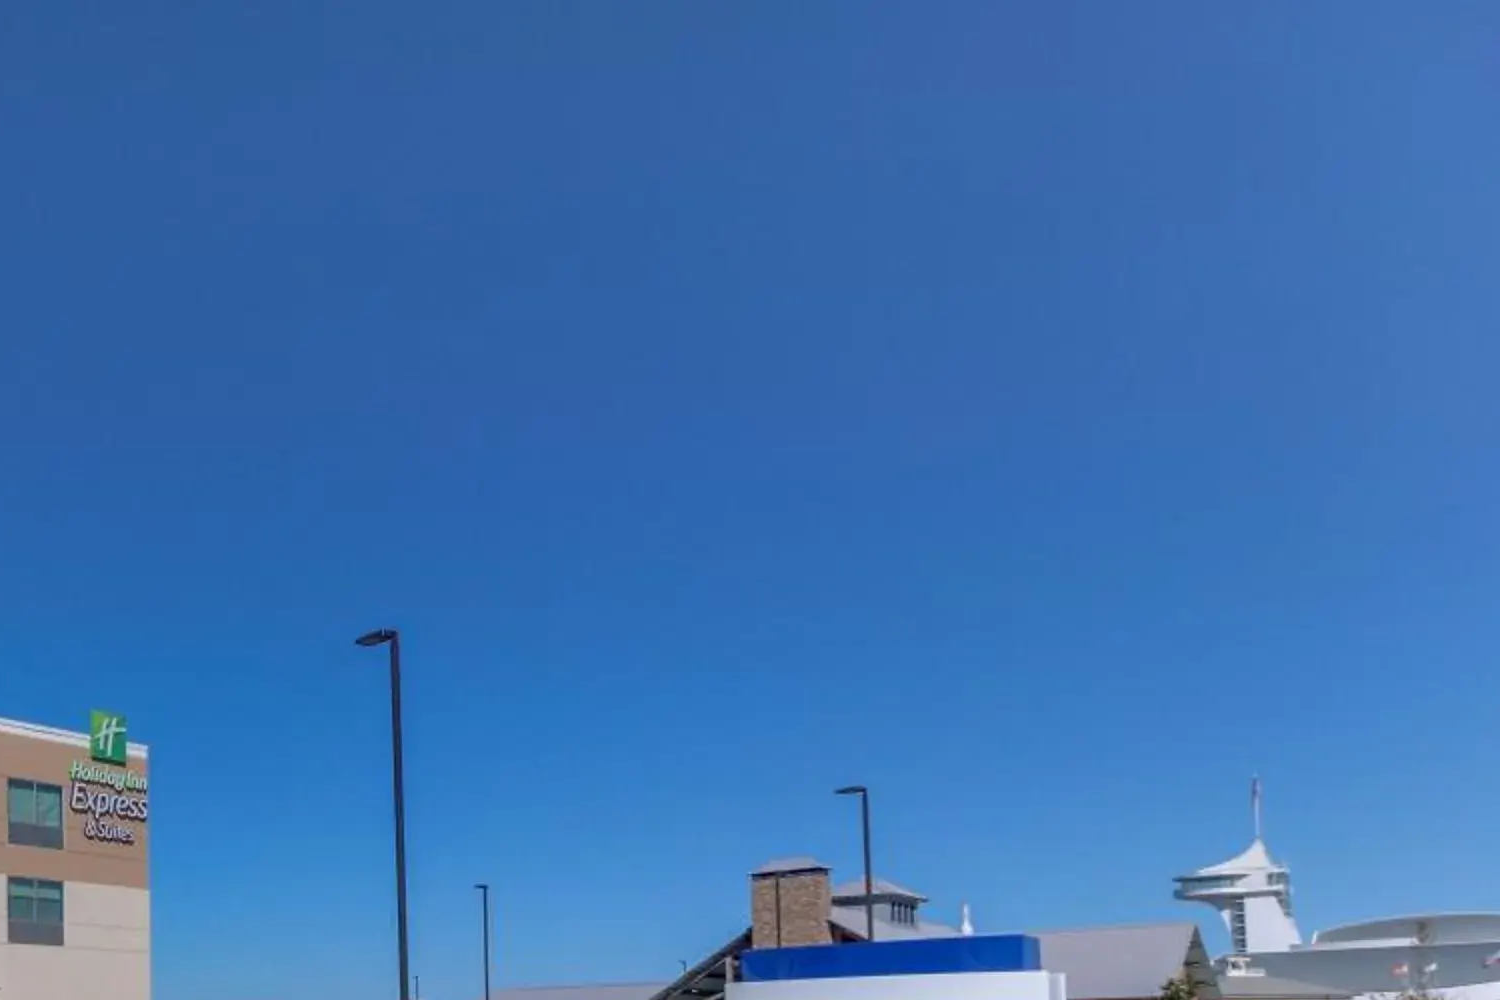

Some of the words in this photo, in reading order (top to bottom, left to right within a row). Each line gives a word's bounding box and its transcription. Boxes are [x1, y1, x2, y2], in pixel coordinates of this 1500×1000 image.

[70, 761, 124, 790] Holiday
[125, 771, 147, 790] Inn
[71, 781, 148, 818] Express
[85, 819, 95, 838] &
[98, 821, 135, 841] Suites
